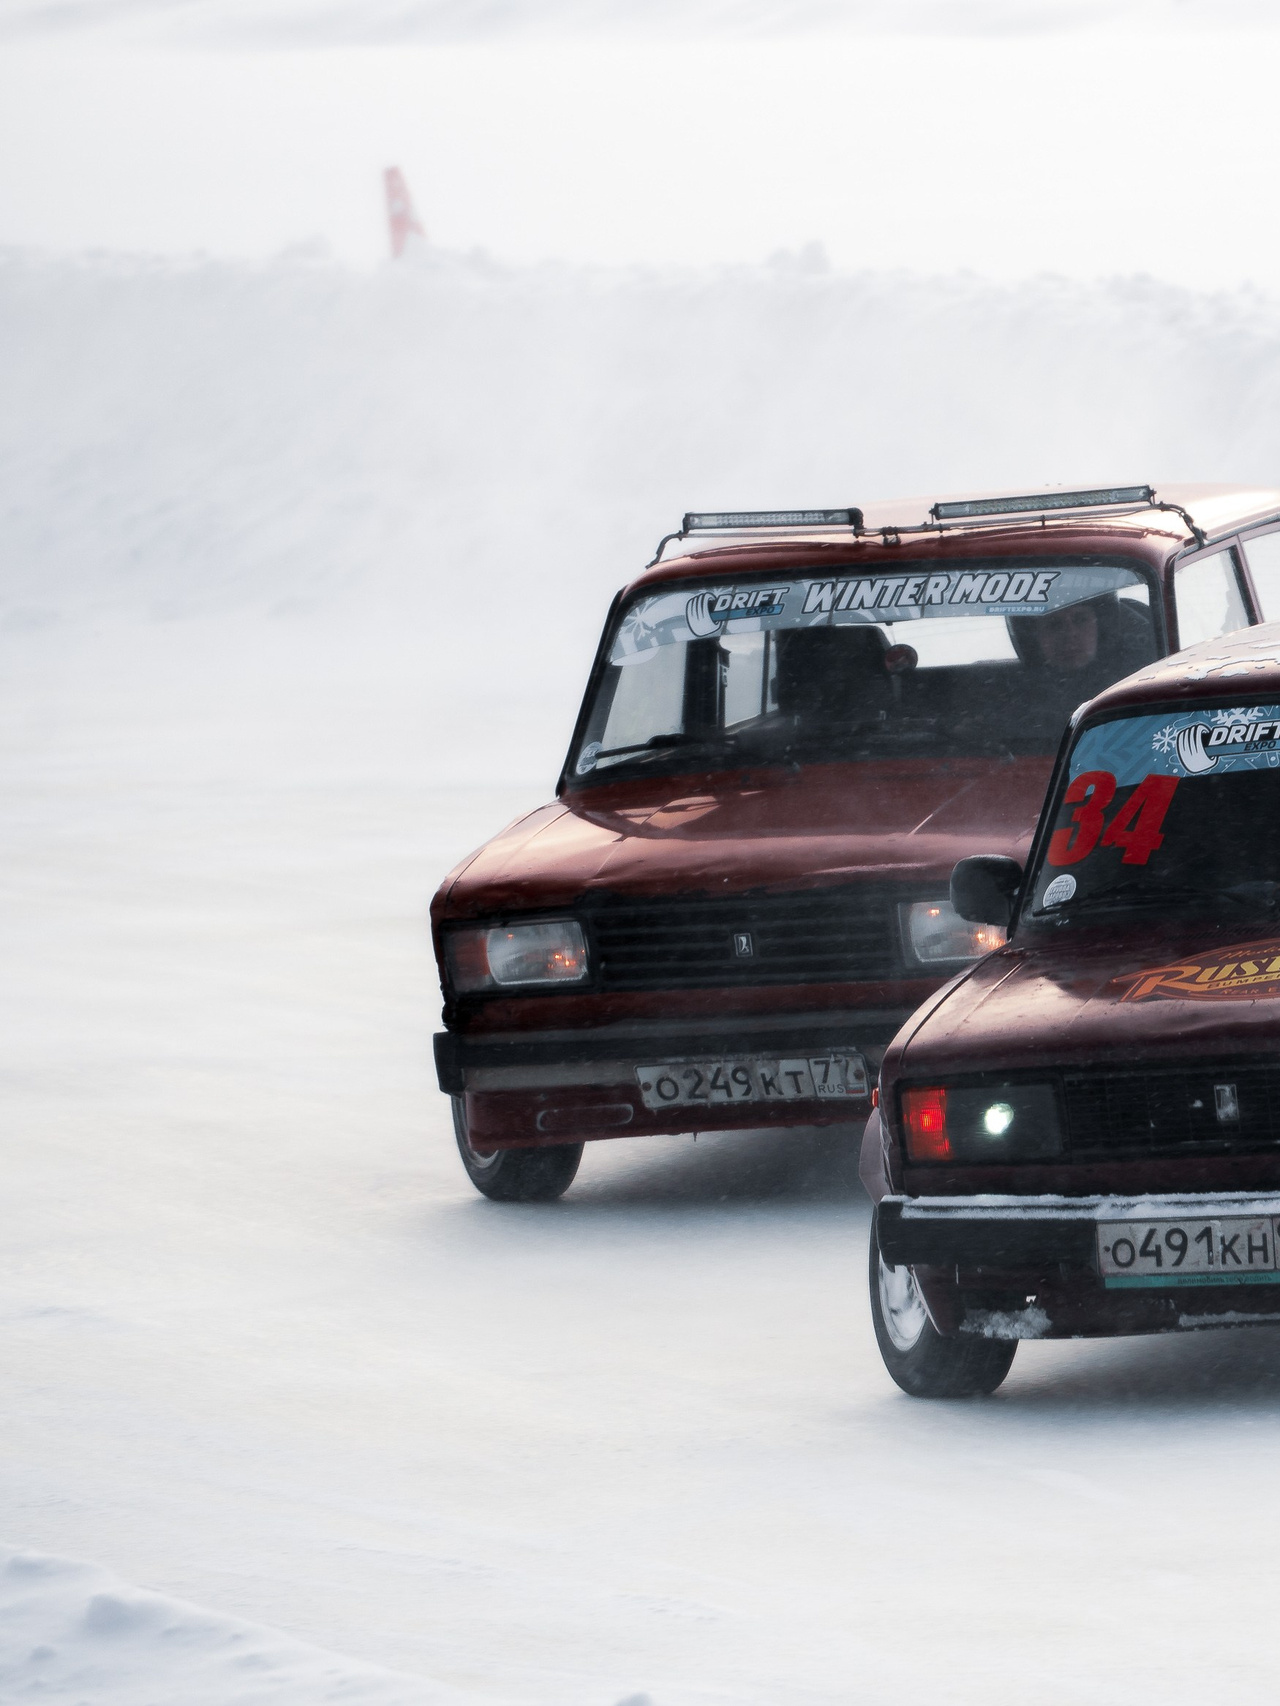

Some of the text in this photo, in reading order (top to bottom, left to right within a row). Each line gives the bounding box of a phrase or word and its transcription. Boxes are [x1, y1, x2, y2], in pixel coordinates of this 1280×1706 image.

[714, 588, 789, 611] DRIFT
[802, 571, 1061, 614] WINTER MODE
[746, 607, 776, 616] EXPO
[1244, 741, 1277, 751] EXPO
[1046, 769, 1181, 867] 34
[818, 1084, 845, 1094] RUS
